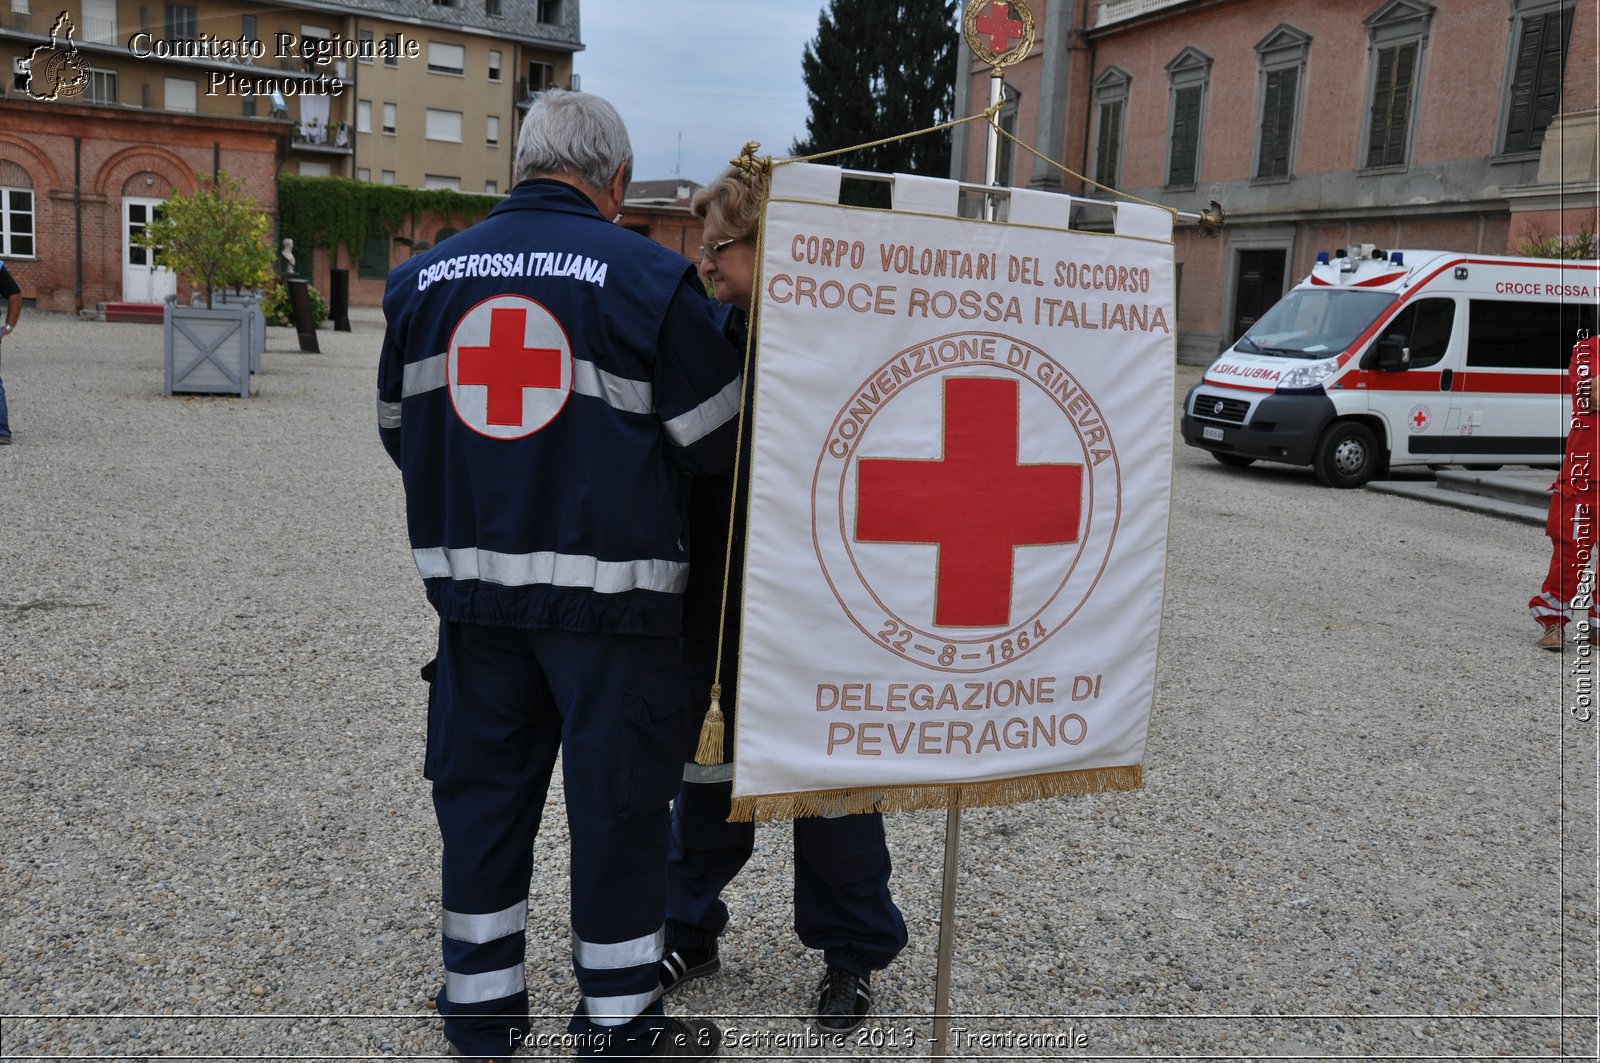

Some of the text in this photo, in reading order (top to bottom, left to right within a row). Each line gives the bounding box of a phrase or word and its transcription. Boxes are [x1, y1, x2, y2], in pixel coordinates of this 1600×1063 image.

[526, 252, 608, 288] ITALIANA
[791, 234, 1150, 293] CORPO VOLONTARI DEL SOCCORSO
[768, 273, 1170, 334] CROCE ROSSA ITALIANA
[1495, 282, 1541, 295] CROCE
[1545, 284, 1589, 297] ROSSA
[828, 338, 1112, 467] CONVENZIONE DI GINEVRA
[816, 674, 1102, 711] DELEGAZIONE DI
[827, 713, 1087, 755] PEVERAGNO
